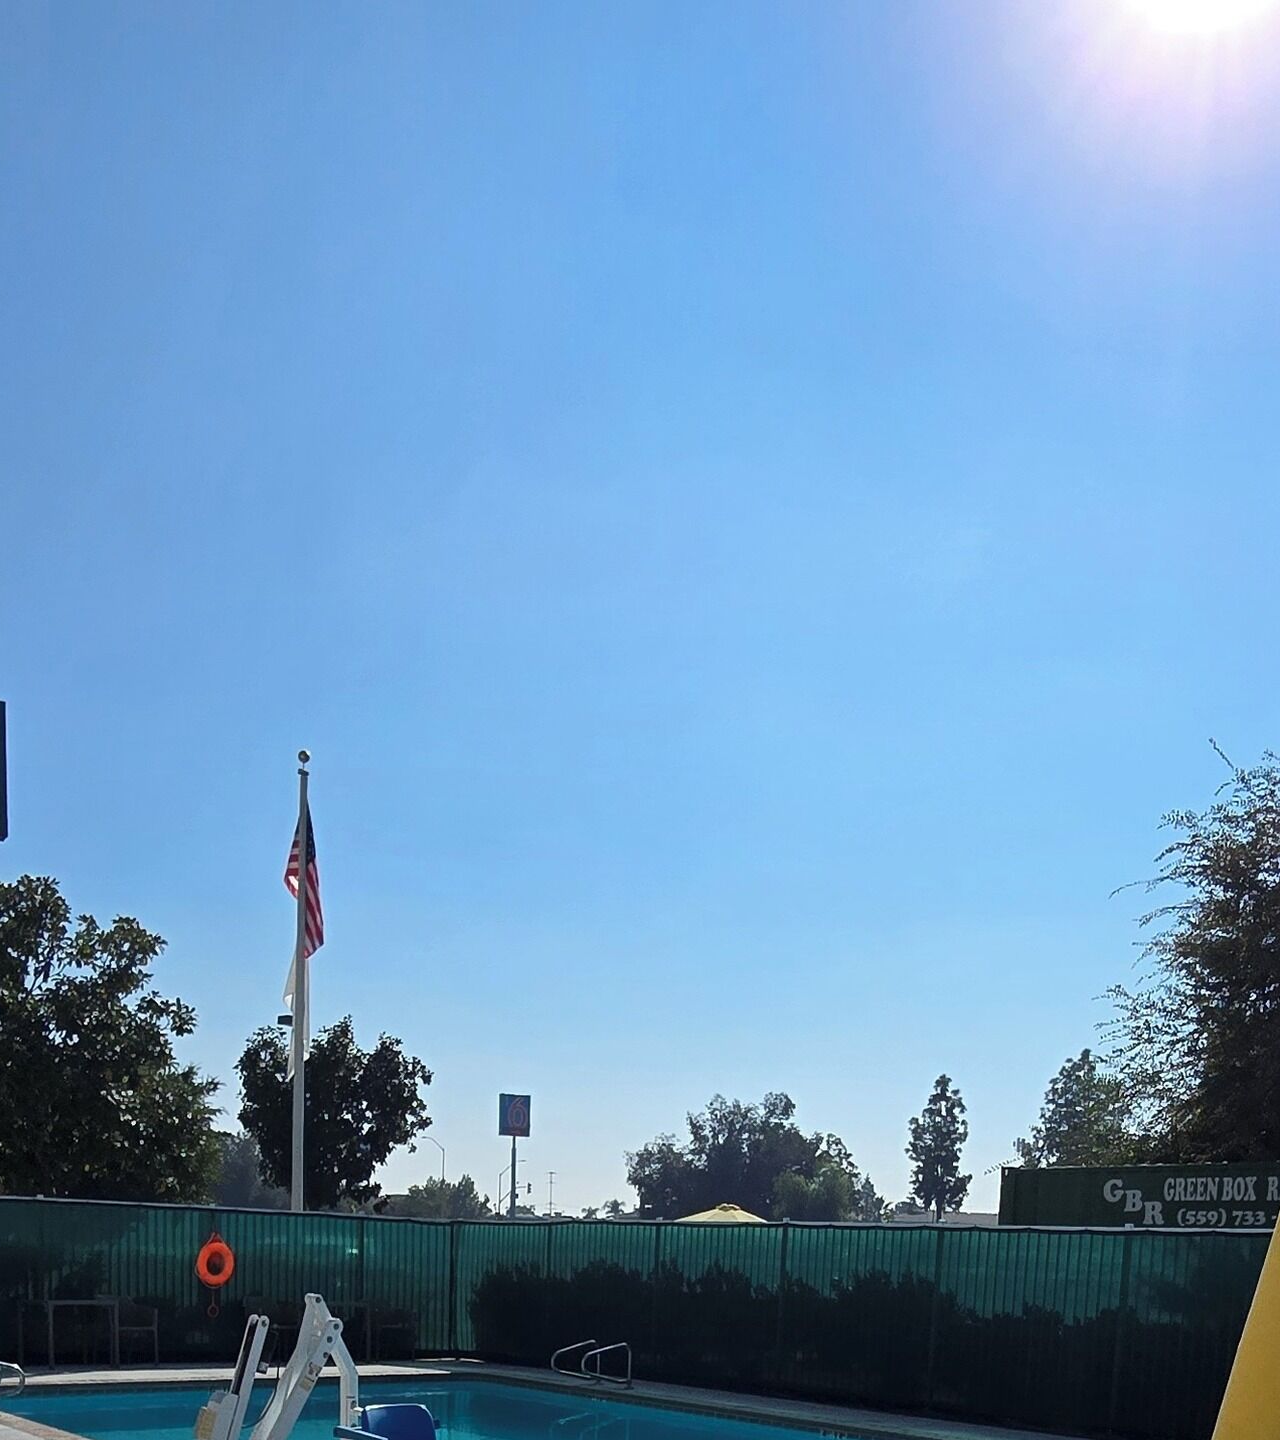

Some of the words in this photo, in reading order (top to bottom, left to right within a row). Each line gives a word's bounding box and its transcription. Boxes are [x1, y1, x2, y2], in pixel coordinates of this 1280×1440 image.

[1163, 1177, 1219, 1201] GREEN
[1221, 1176, 1257, 1201] BOX
[1177, 1208, 1227, 1227] (559)
